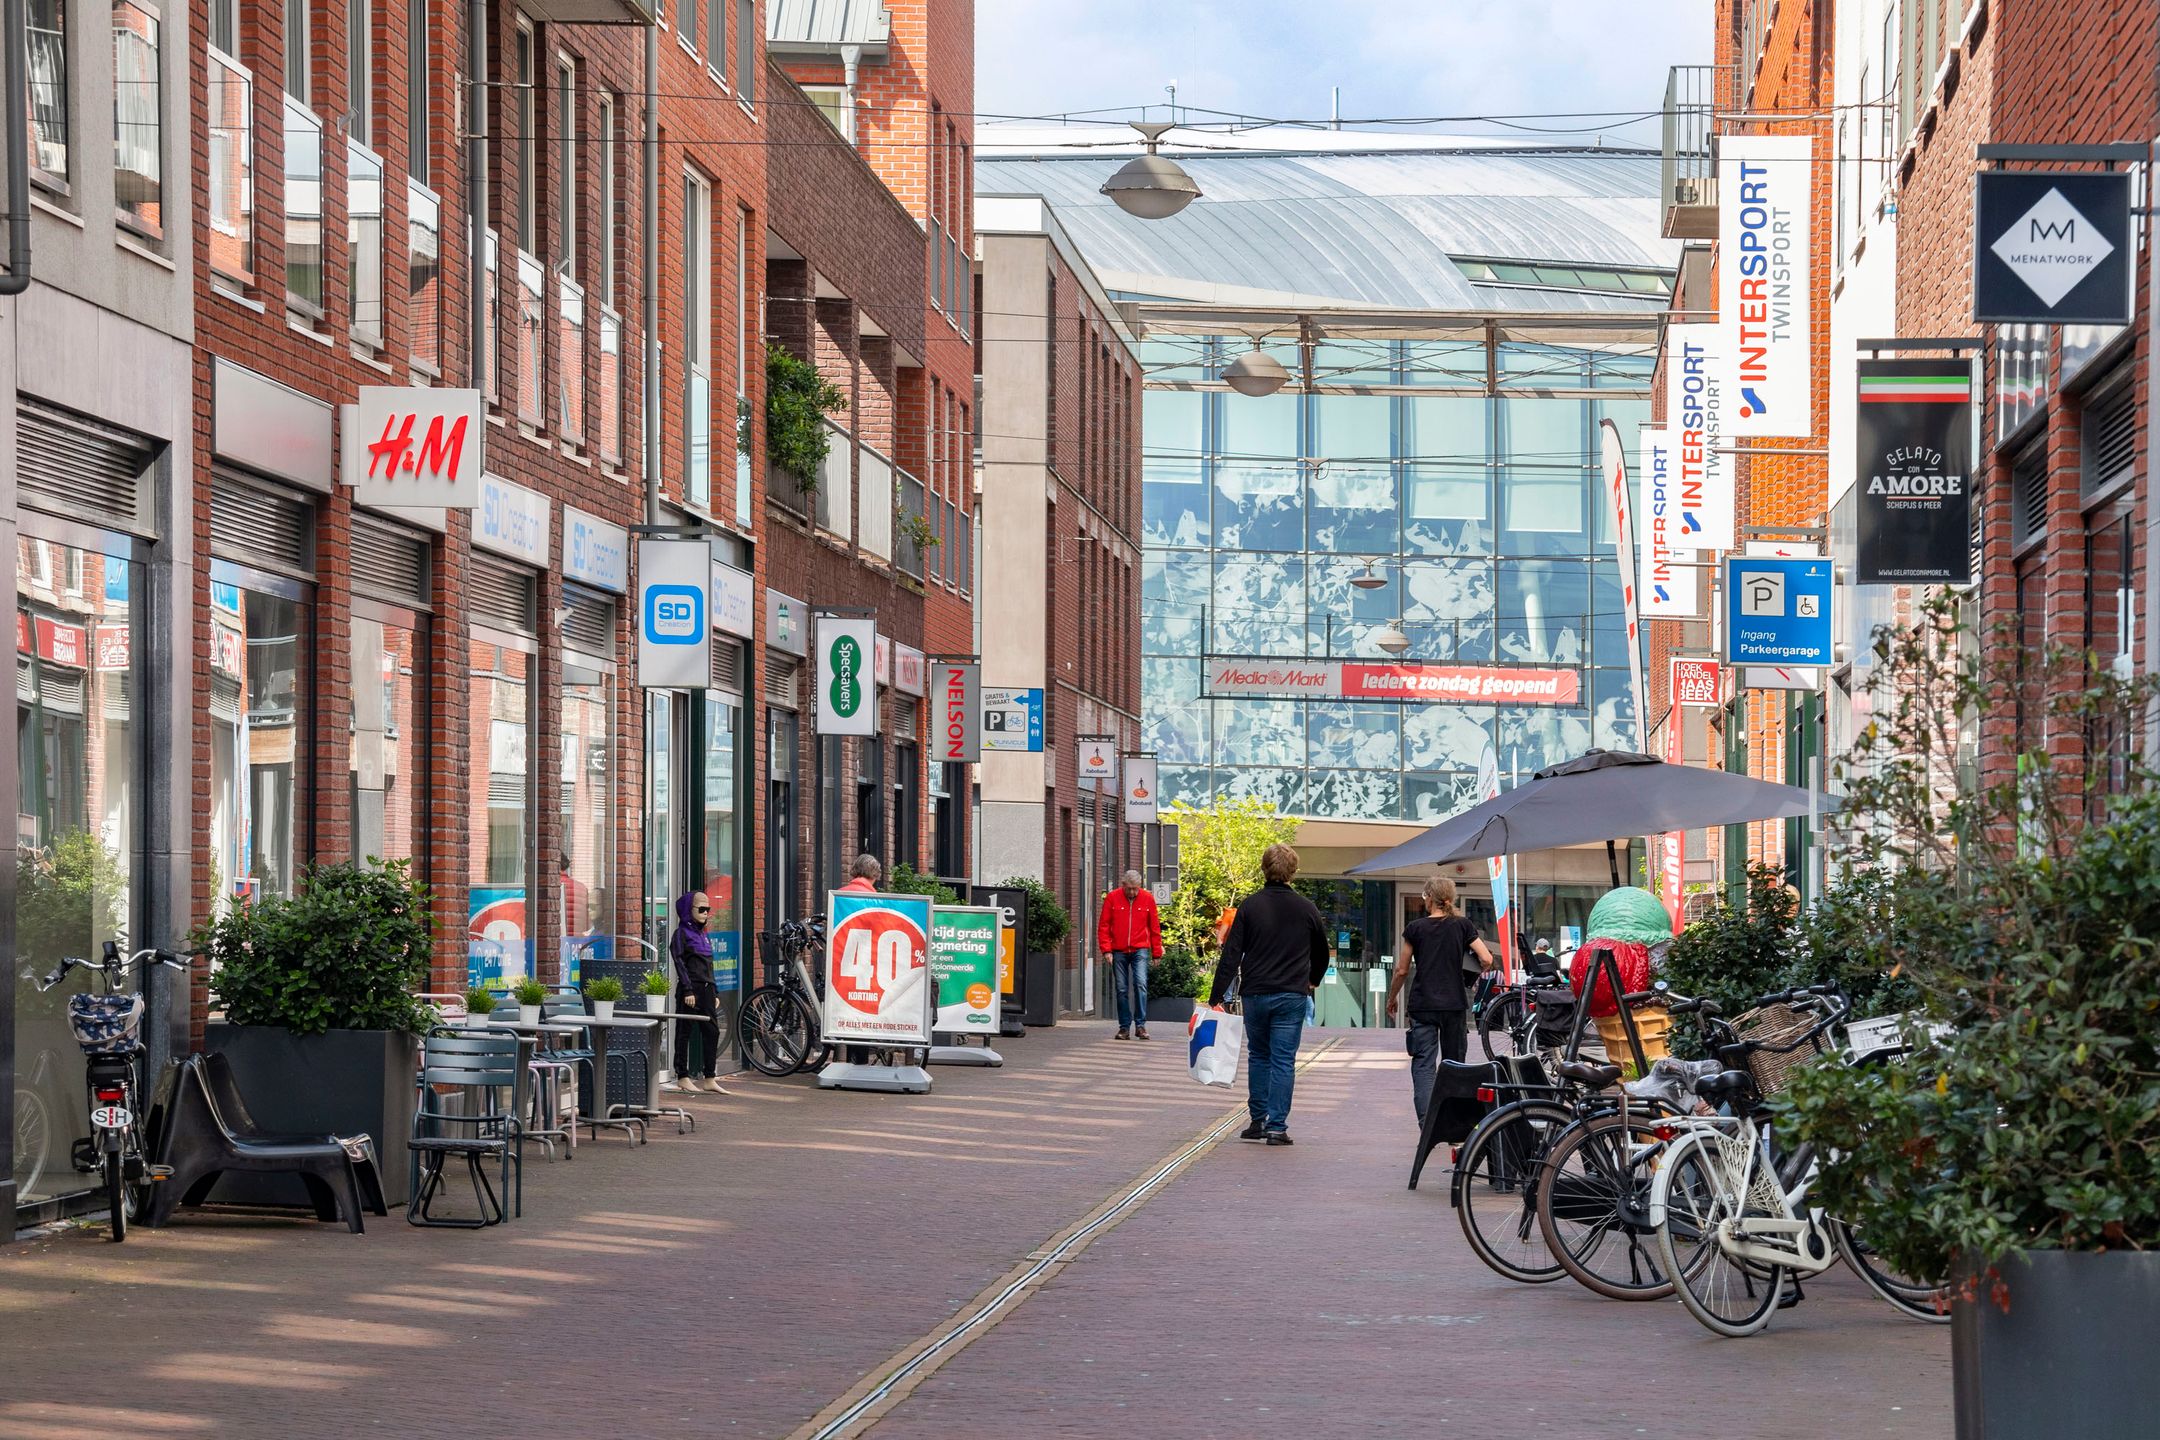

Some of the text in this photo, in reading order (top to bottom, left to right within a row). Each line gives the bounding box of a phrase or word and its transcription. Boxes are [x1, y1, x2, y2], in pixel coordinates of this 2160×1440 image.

[2010, 254, 2094, 264] MENATWORK
[1740, 161, 1767, 382] INTERSPORT
[1772, 206, 1791, 343] TWINSPORT
[1681, 341, 1705, 508] INTERSPORT
[1706, 376, 1720, 480] TWINSPORT
[368, 413, 469, 481] H&M
[1886, 446, 1942, 466] GELATO
[1867, 475, 1962, 495] AMORE
[484, 483, 499, 537] SD
[1886, 501, 1917, 509] SCHEPIJS
[1923, 501, 1942, 509] MEER
[573, 522, 586, 570] SD
[658, 602, 691, 620] SD
[658, 620, 692, 628] Creation
[1740, 630, 1777, 642] Ingang
[1740, 643, 1821, 656] Parkeergarage
[838, 642, 853, 711] Specsavers
[1215, 669, 1328, 687] Media Markt
[1362, 672, 1558, 696] Iedere zondag geopend
[947, 669, 965, 758] NELSON
[957, 927, 993, 940] gratis
[848, 991, 878, 1001] KORTING
